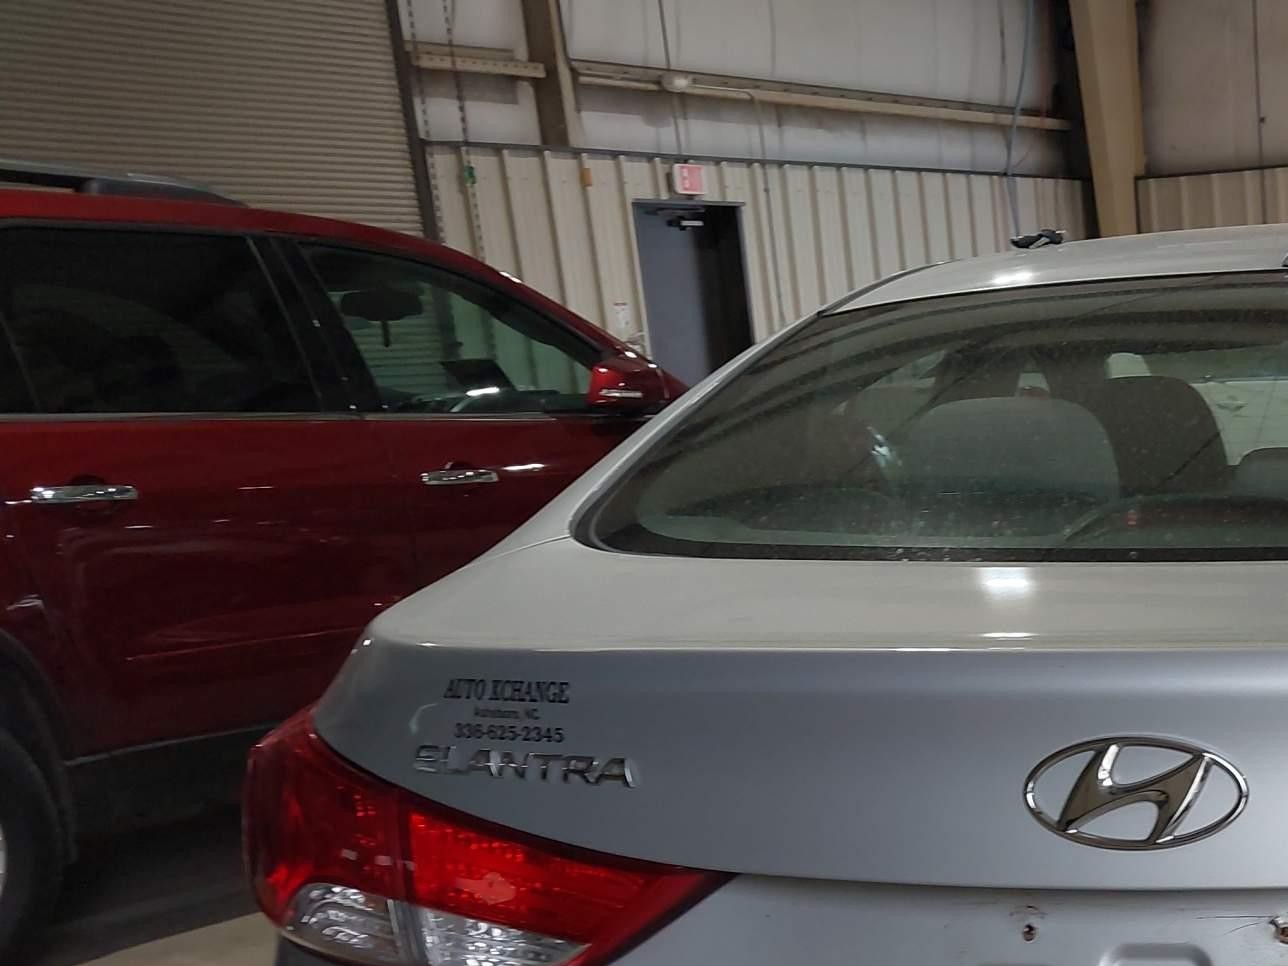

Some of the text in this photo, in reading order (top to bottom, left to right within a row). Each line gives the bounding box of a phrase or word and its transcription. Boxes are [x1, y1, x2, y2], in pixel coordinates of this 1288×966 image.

[443, 678, 486, 699] AUTO
[454, 722, 564, 743] 336-625-2345
[414, 744, 638, 789] ELANTRA
